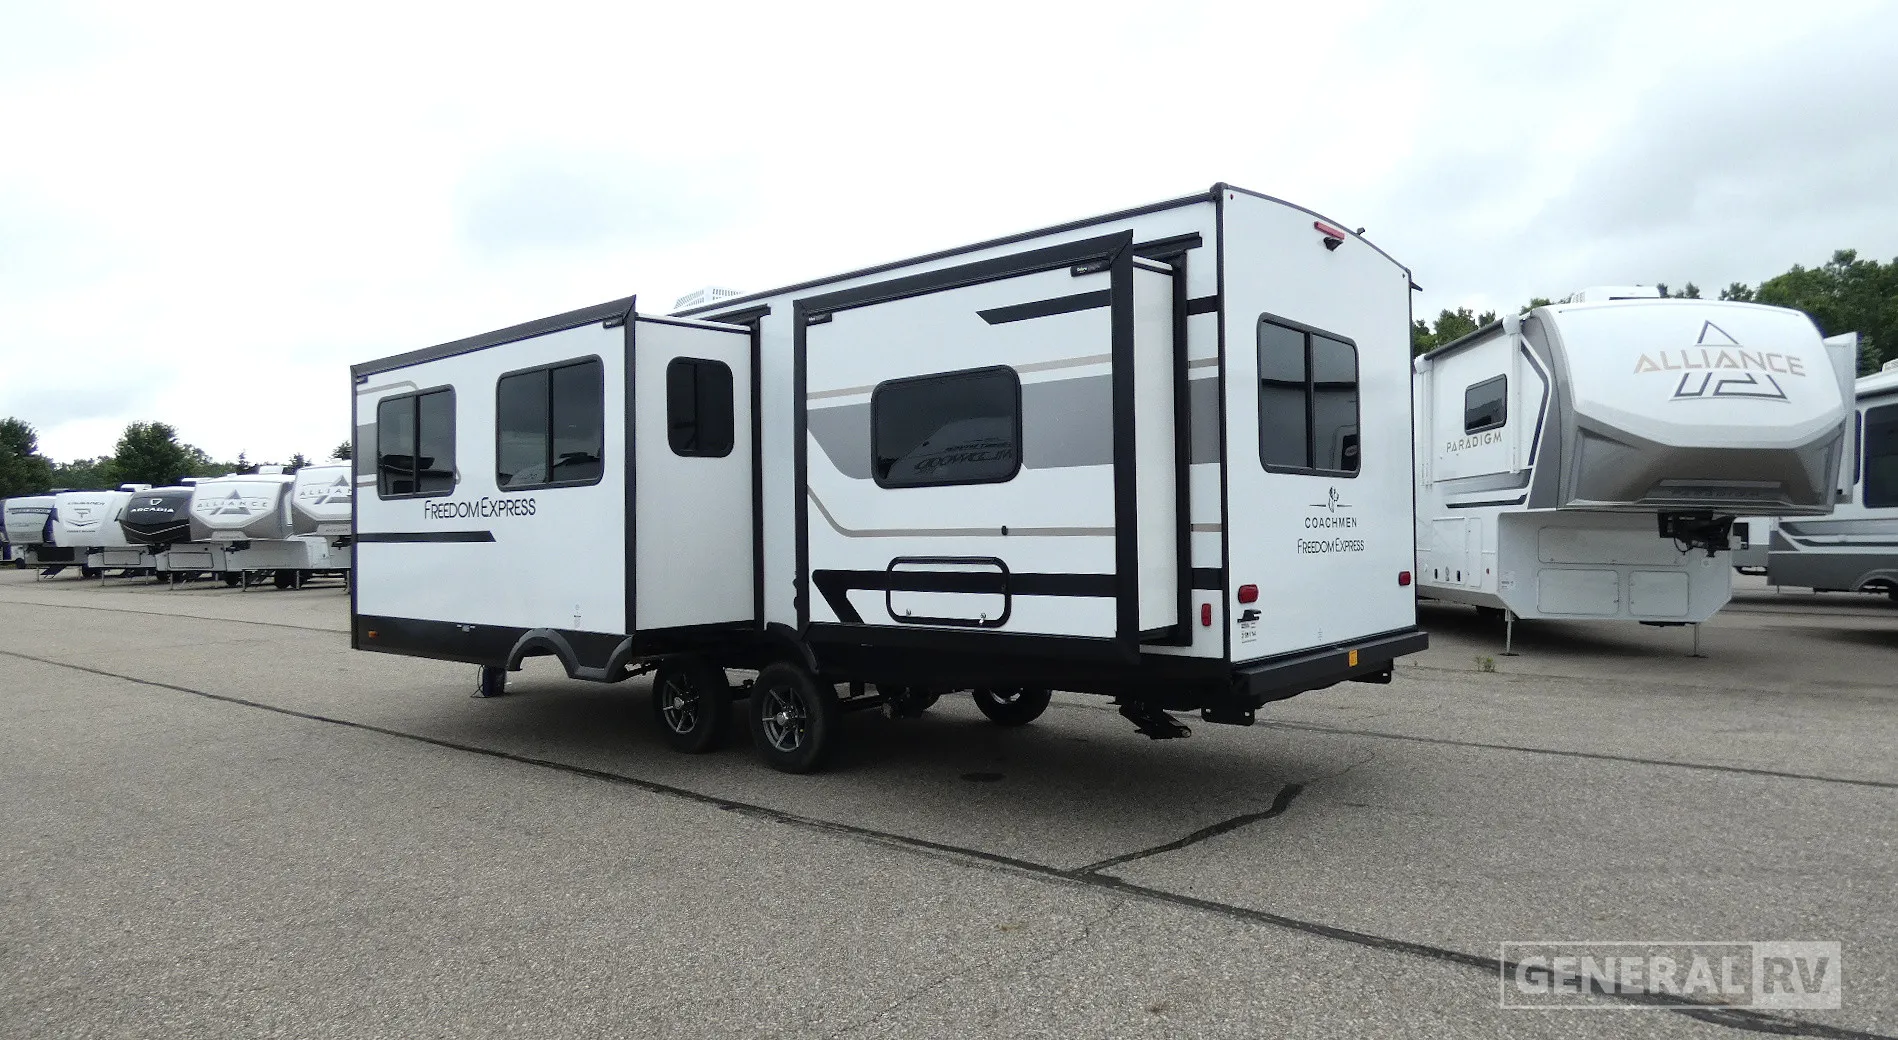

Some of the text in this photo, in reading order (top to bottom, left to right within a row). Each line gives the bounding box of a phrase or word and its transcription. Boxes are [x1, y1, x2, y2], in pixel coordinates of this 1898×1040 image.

[1633, 348, 1806, 377] ALLIANCE
[1446, 431, 1502, 453] PARADIGM
[1304, 517, 1357, 529] COACHMEN
